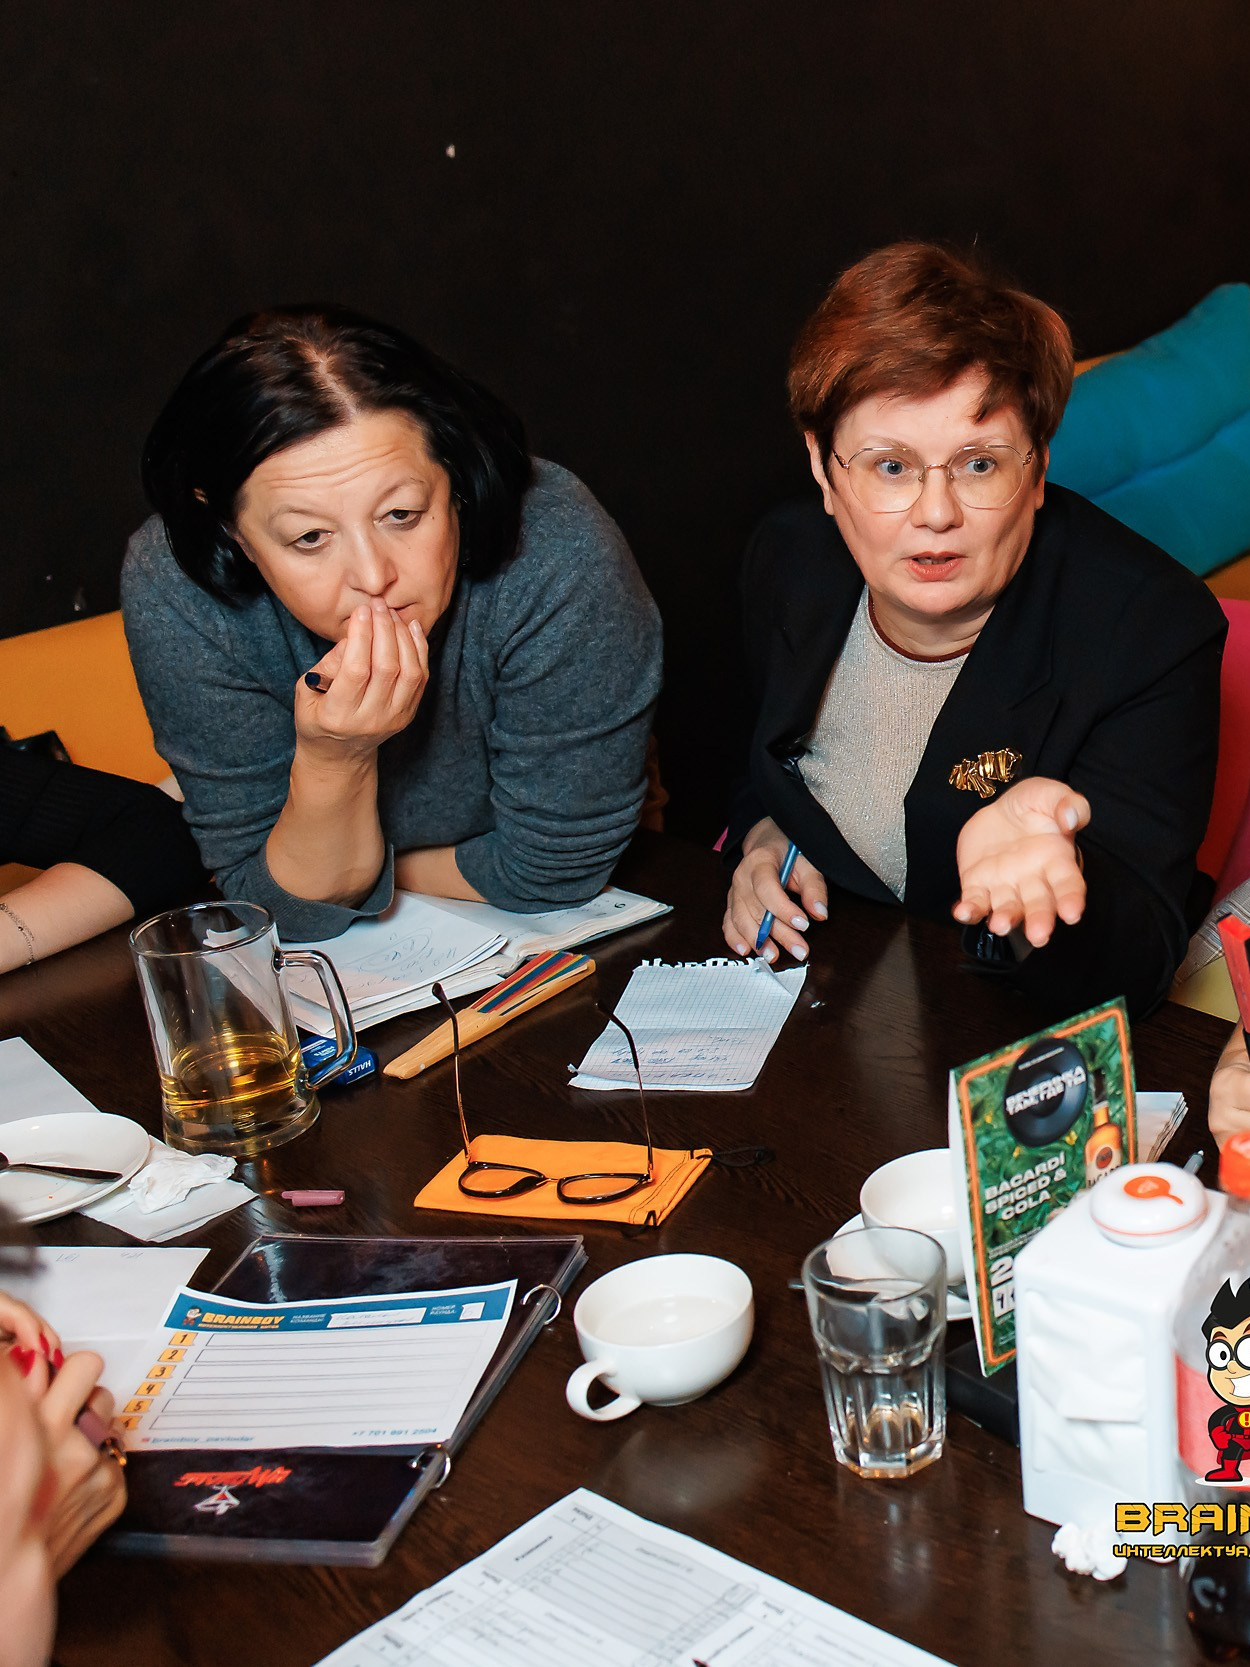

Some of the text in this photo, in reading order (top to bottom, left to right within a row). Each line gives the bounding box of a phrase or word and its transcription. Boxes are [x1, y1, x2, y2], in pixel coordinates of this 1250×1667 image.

[348, 1060, 372, 1076] HALLS
[985, 1151, 1065, 1200] BACARDI
[985, 1175, 1051, 1214] SPICED
[1054, 1168, 1067, 1181] &
[1001, 1190, 1051, 1220] COLA
[202, 1312, 285, 1325] BRAINBOY
[180, 1333, 188, 1344] 1
[168, 1349, 179, 1360] 2
[155, 1366, 166, 1378] 3
[146, 1384, 155, 1395] 4
[133, 1400, 144, 1412] 5
